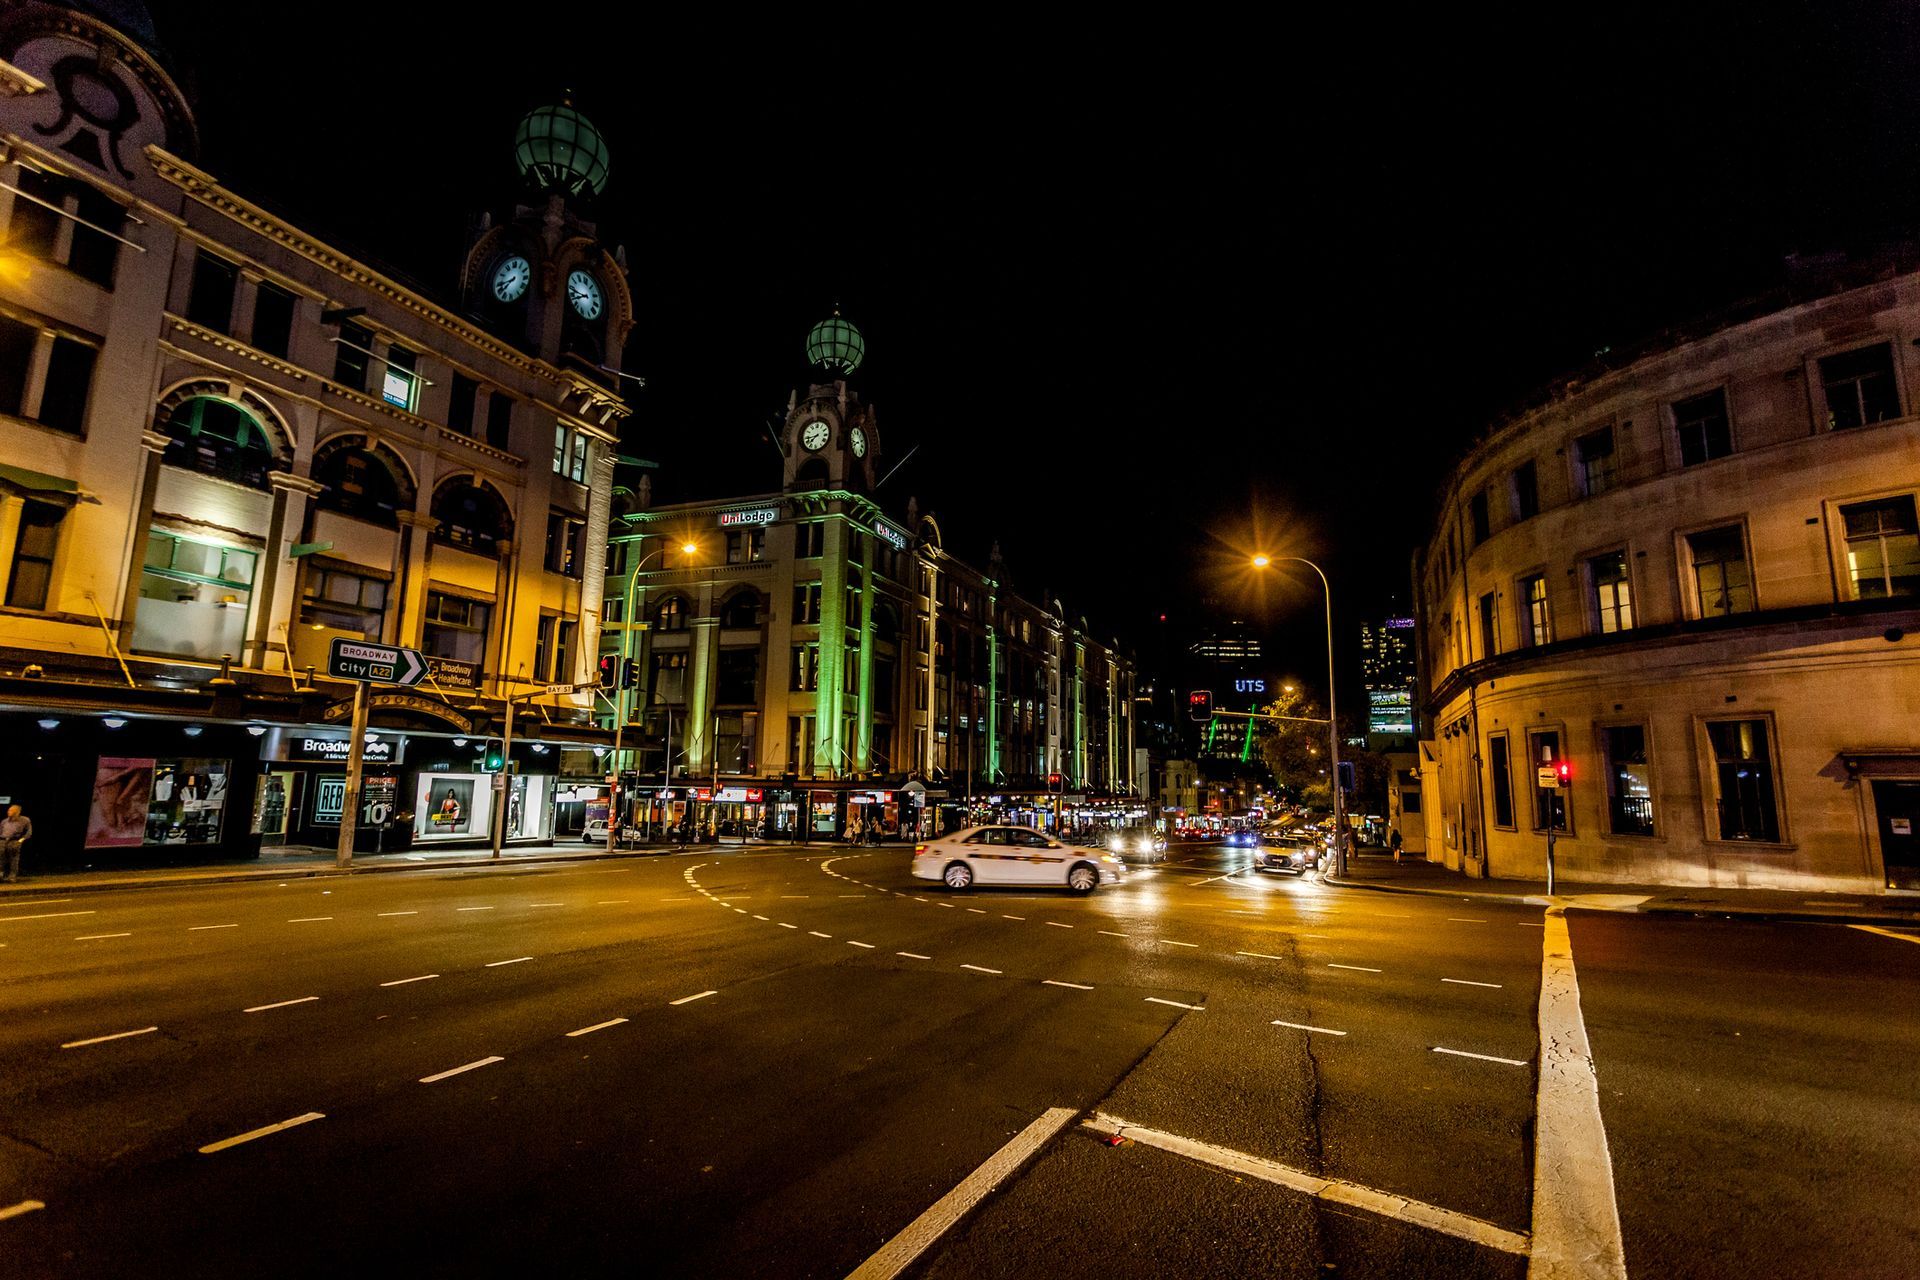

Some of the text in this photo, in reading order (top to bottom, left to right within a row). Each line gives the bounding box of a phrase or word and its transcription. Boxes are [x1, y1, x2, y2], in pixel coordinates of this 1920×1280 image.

[721, 510, 774, 525] UniLodge
[342, 646, 395, 661] BROADWAY
[339, 662, 391, 677] City A22
[440, 661, 471, 677] Broadway
[438, 673, 471, 685] Healthcare
[1235, 679, 1265, 692] UTS
[303, 739, 351, 752] Broadw
[320, 785, 343, 810] REB
